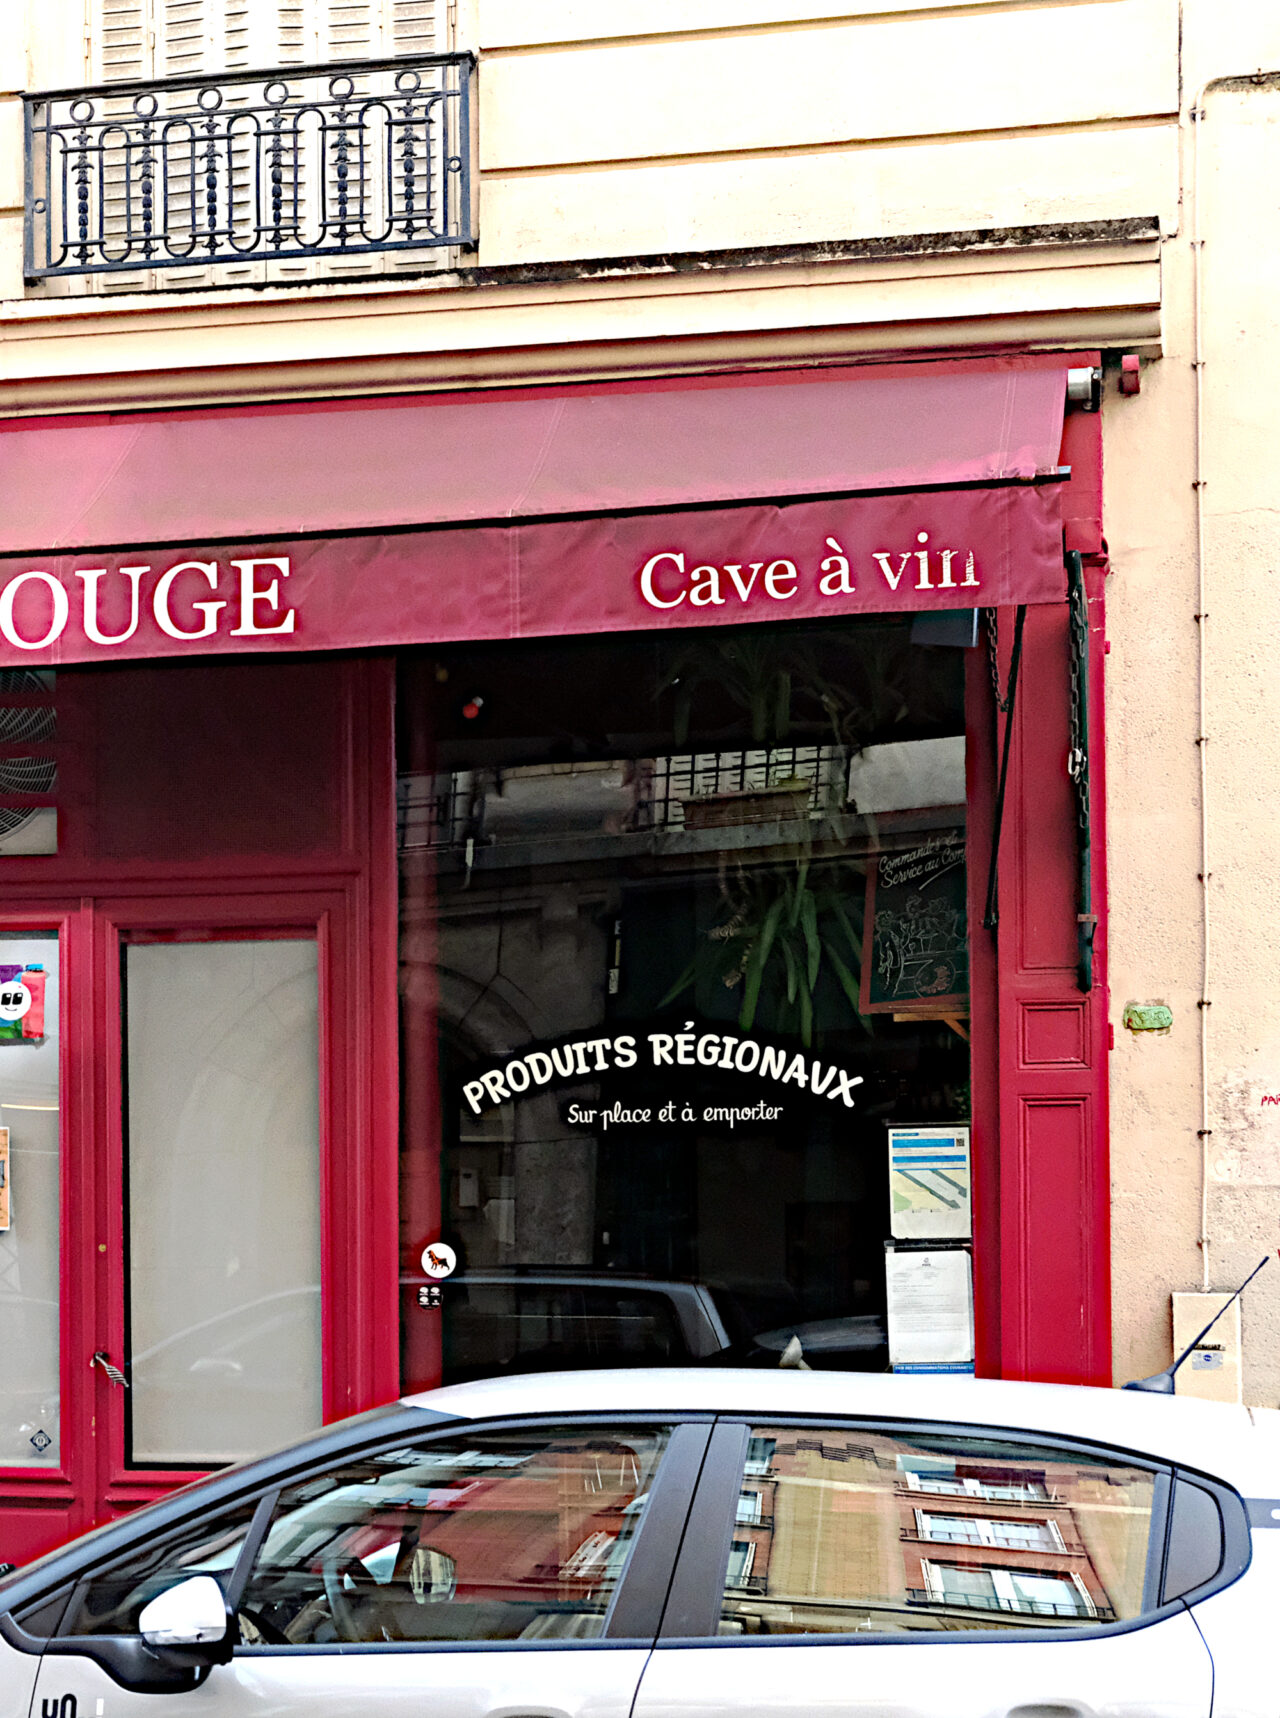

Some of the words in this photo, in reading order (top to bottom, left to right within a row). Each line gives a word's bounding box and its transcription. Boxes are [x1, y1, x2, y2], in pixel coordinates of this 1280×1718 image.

[640, 553, 797, 609] Cave
[819, 537, 856, 596] à
[872, 531, 980, 591] vin
[881, 863, 923, 888] Service
[463, 1034, 637, 1114] PRODUITS
[647, 1021, 864, 1107] RÉGIONAUX
[567, 1104, 595, 1124] Sur
[600, 1100, 651, 1130] place
[658, 1103, 677, 1122] et
[682, 1101, 696, 1122] à
[703, 1099, 783, 1129] emporter
